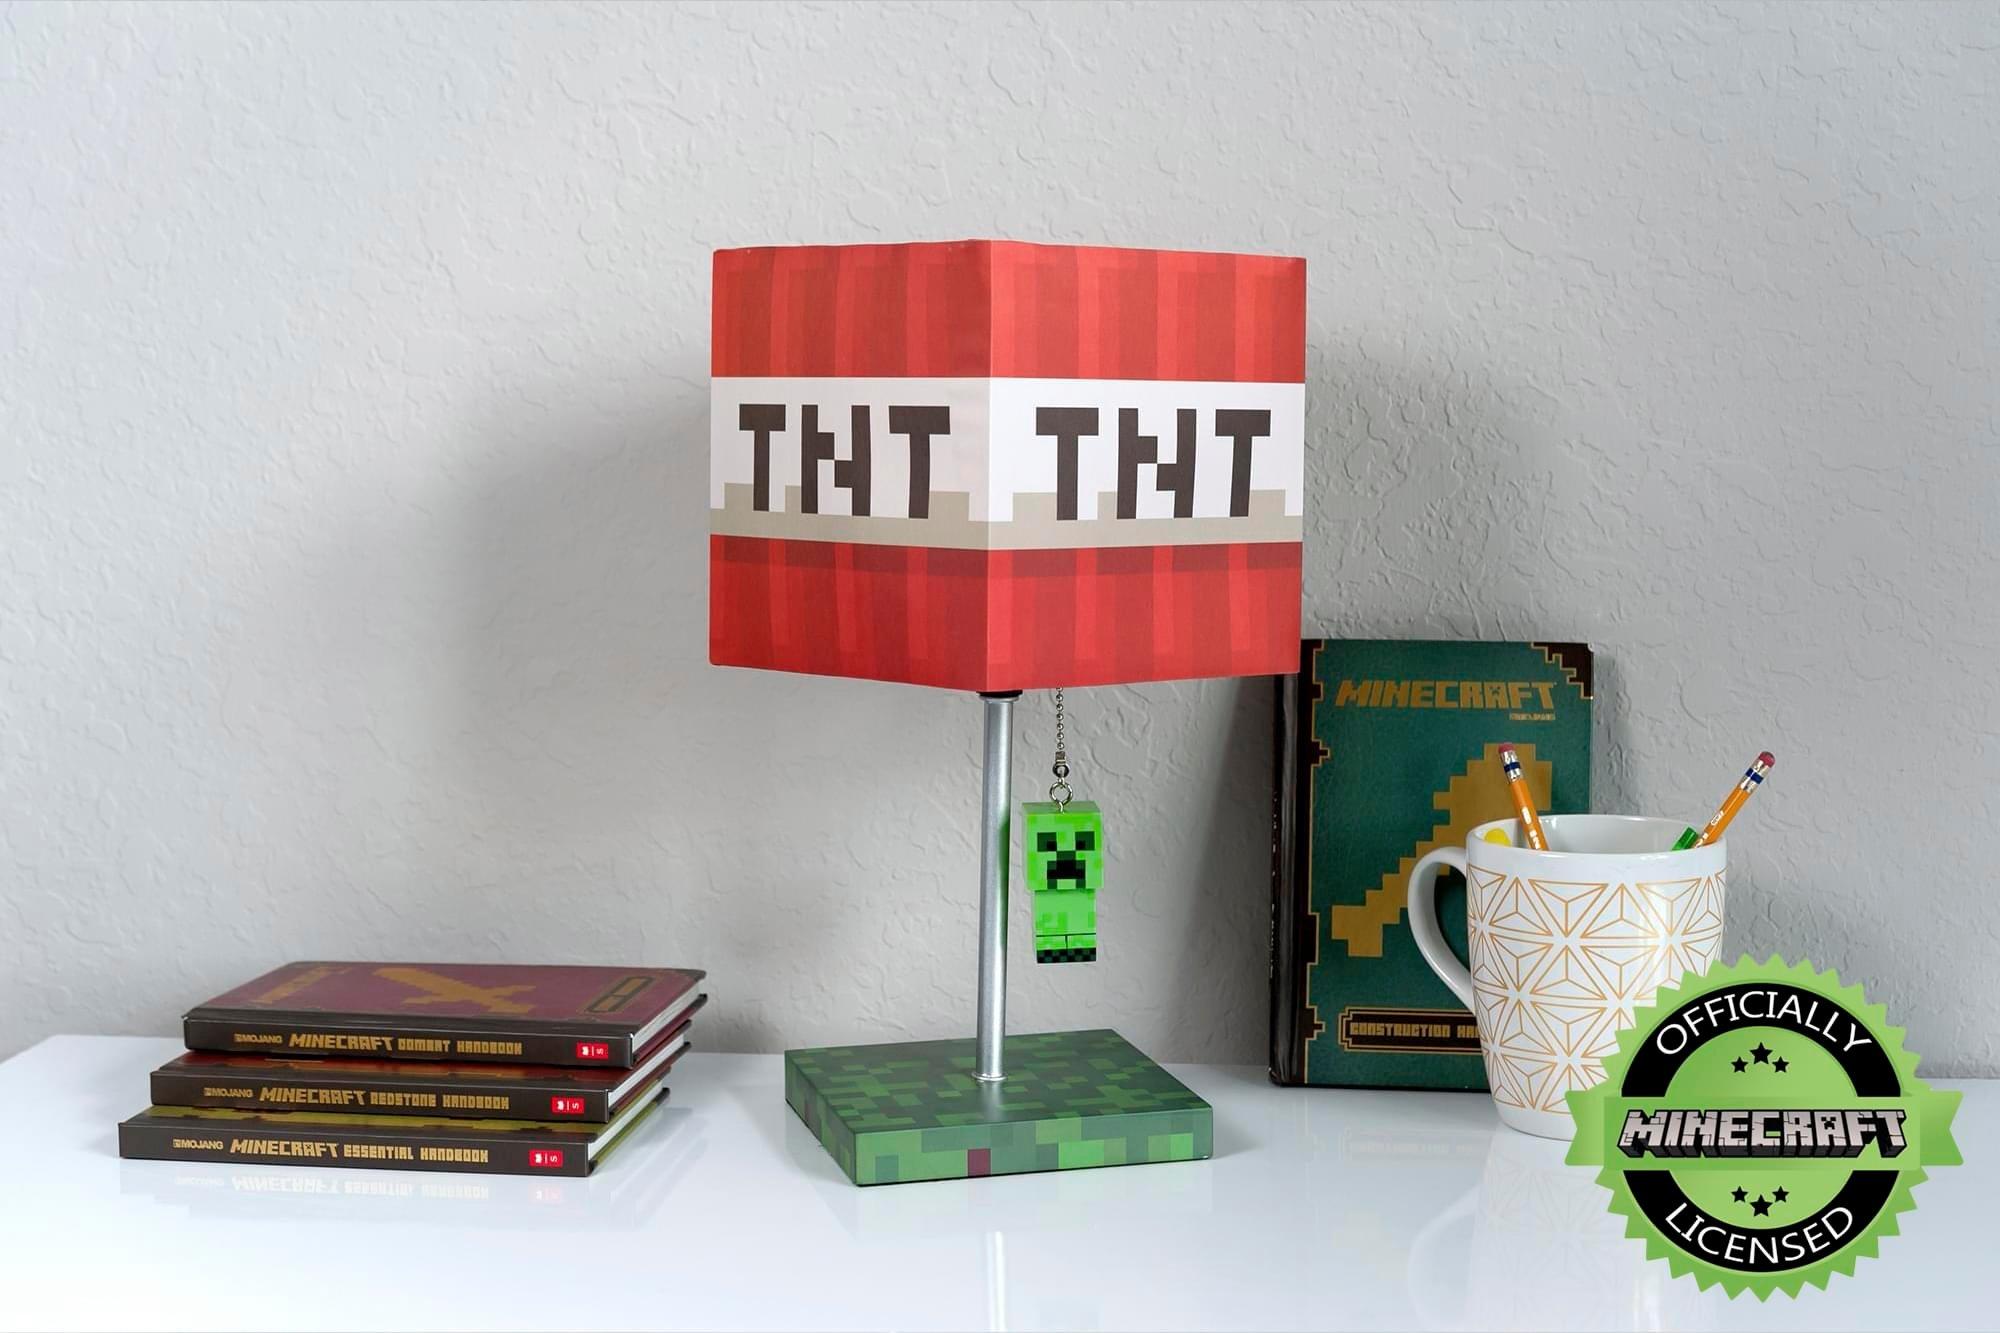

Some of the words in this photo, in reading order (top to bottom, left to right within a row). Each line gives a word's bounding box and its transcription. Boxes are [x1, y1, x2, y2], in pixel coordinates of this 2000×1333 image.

[738, 403, 951, 520] TNT
[1035, 406, 1272, 521] TNT
[1335, 680, 1558, 709] MINECRAFT
[1350, 1022, 1450, 1038] CONSTRUCTION
[288, 1033, 394, 1050] MINECRAFT
[456, 1040, 523, 1055] HANDBOOK
[259, 1087, 366, 1105] MINECRAFT
[370, 1091, 436, 1107] REDSTONE
[442, 1095, 510, 1110] HANDBOOK
[181, 1140, 224, 1151] MOJANG
[230, 1138, 337, 1158] MINECRAFT
[343, 1144, 414, 1160] ESSENTIAL
[420, 1147, 489, 1163] HANDBOOK
